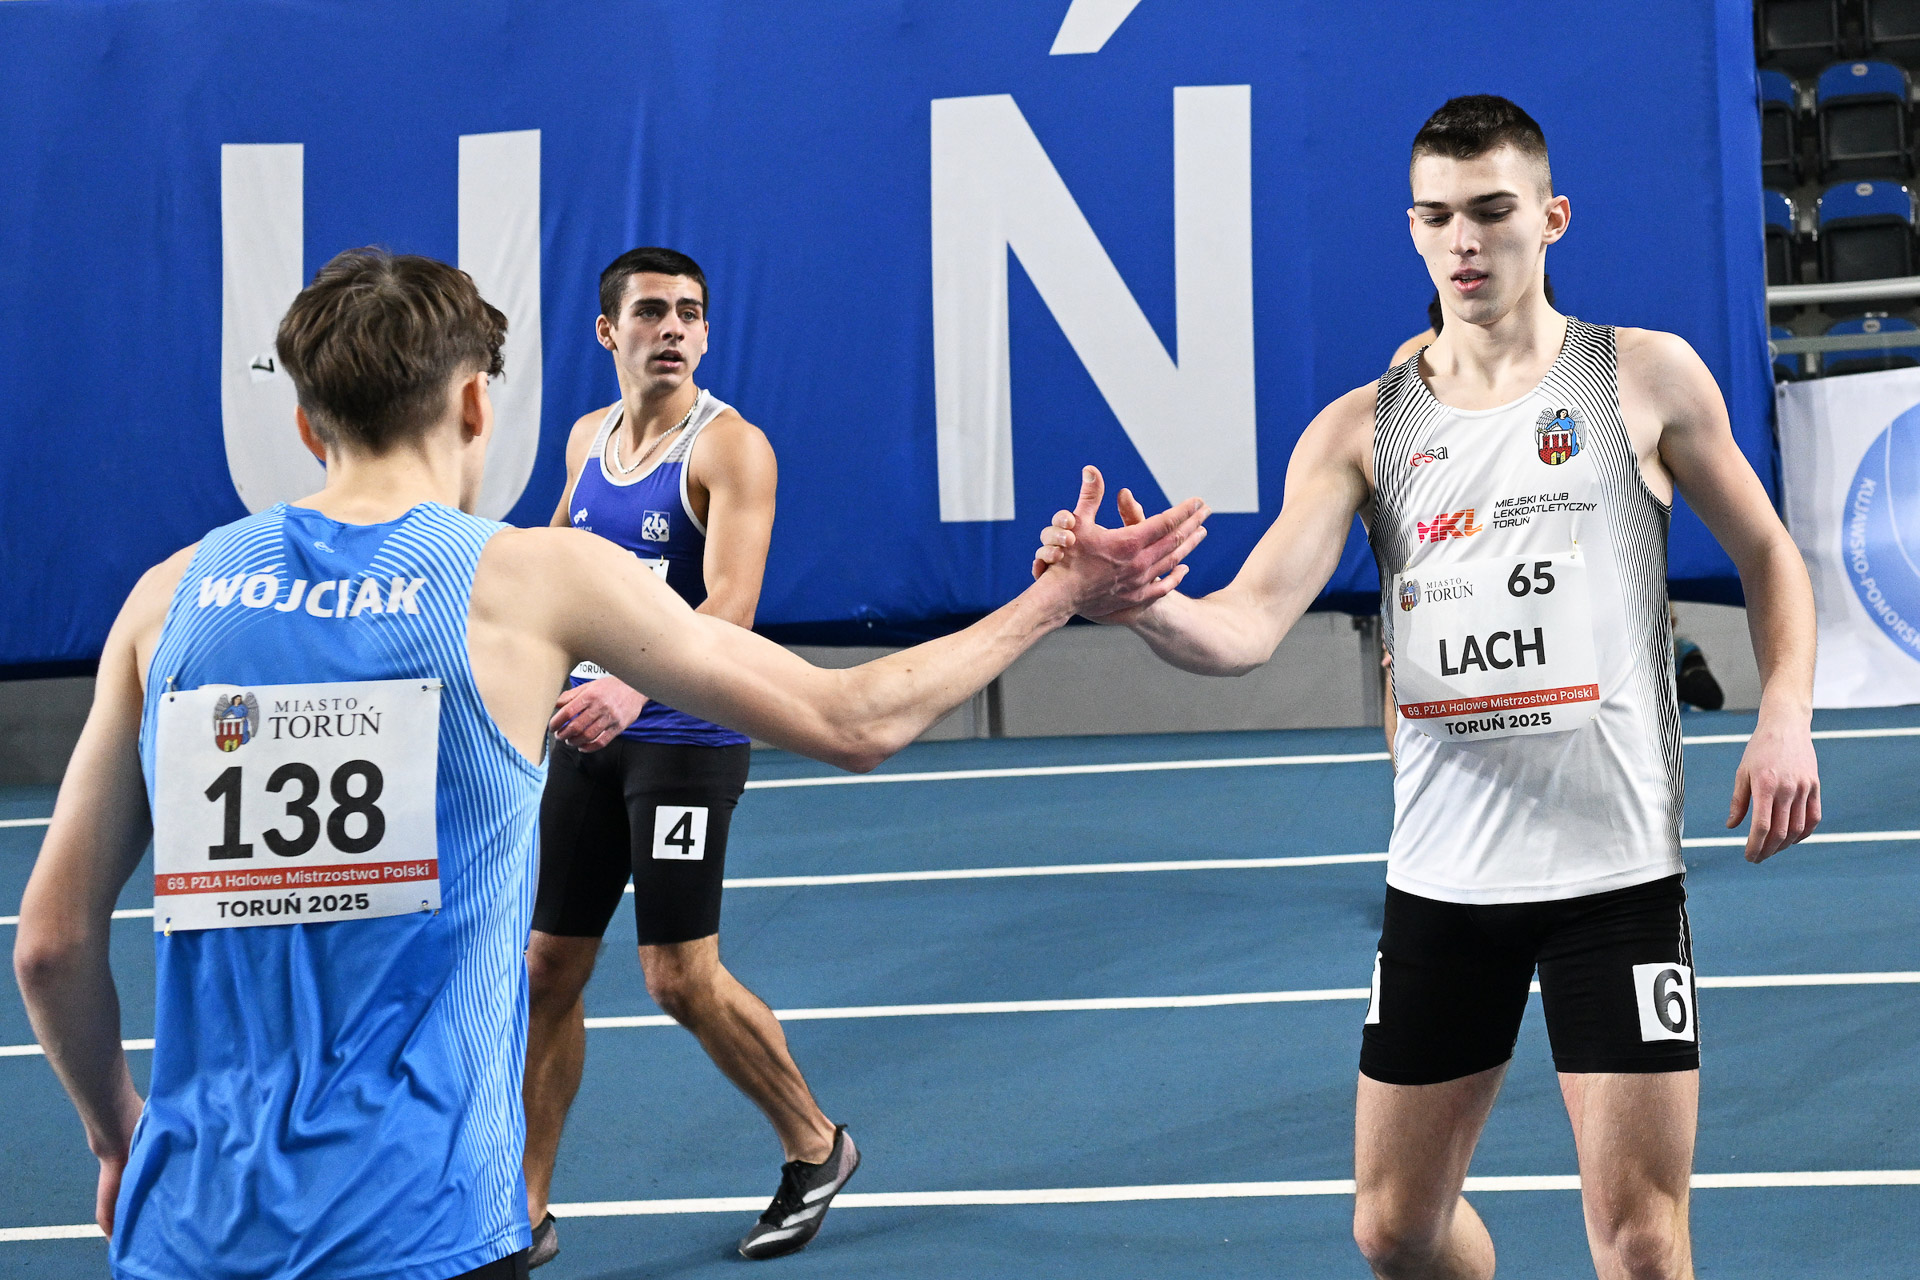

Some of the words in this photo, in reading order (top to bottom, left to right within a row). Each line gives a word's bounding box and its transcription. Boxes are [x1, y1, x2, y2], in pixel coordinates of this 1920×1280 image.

[1493, 502, 1598, 519] LEKKOATLETYCZNY
[1494, 495, 1537, 509] MIEJSKI
[1539, 492, 1569, 503] KLUB
[1417, 508, 1484, 544] MKL
[1493, 515, 1531, 529] TORUŃ
[198, 565, 427, 618] WÓJCIAK
[1424, 581, 1474, 603] TORUŃ
[1426, 577, 1462, 589] MIASTO
[1507, 561, 1556, 597] 65
[1439, 627, 1546, 677] LACH
[274, 697, 359, 713] MIASTO
[1407, 707, 1423, 717] 69.
[1424, 703, 1447, 715] PZLA
[1449, 699, 1488, 713] Halowe
[1490, 692, 1558, 708] Mistrzostwa
[1560, 686, 1593, 700] Polski
[268, 705, 382, 740] TORUŃ
[1445, 713, 1505, 735] TORUŃ
[1509, 712, 1552, 729] 2025
[204, 759, 386, 861] 138
[664, 811, 695, 855] 4
[167, 877, 189, 891] 69.
[191, 875, 222, 890] PZLA
[226, 871, 283, 888] Halowe
[286, 865, 381, 885] Mistrzostwa
[384, 863, 430, 880] Polski
[218, 892, 301, 919] TORUŃ
[308, 892, 370, 913] 2025
[1653, 969, 1687, 1034] 6
